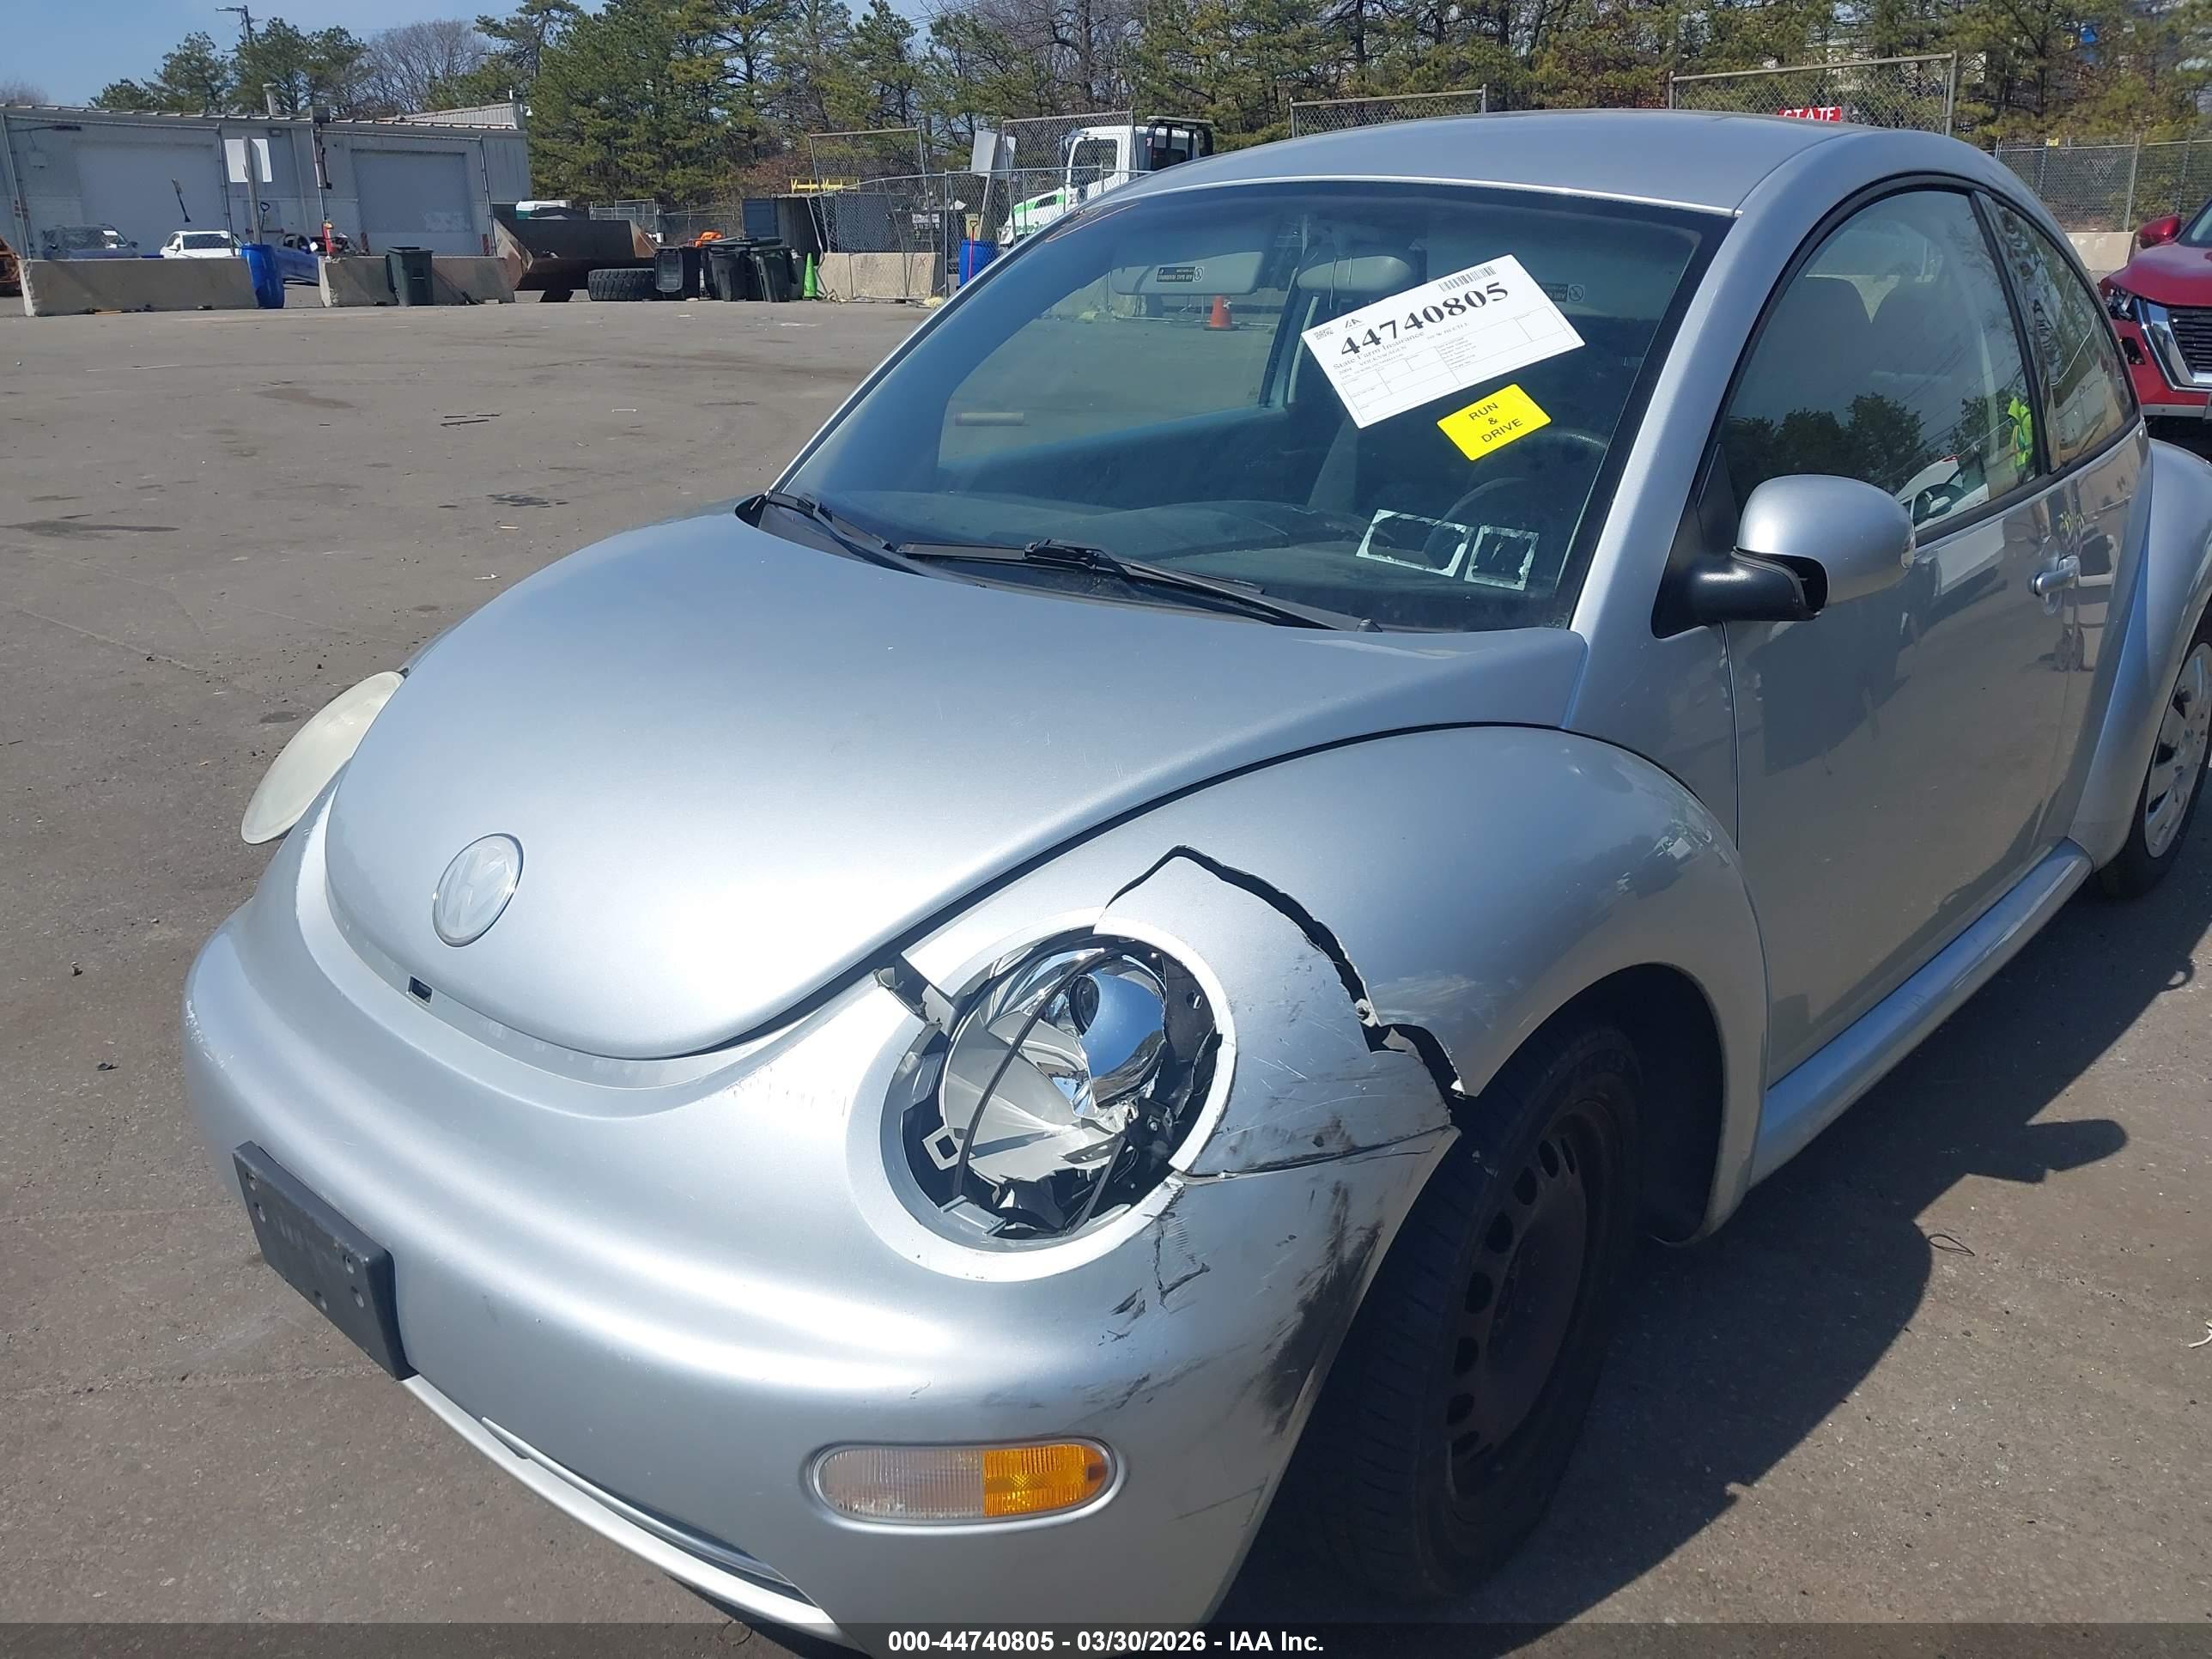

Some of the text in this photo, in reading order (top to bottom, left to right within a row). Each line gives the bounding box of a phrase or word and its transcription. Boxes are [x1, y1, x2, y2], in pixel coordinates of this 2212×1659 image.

[1341, 282, 1509, 355] 44740805
[1333, 357, 1356, 370] State
[1357, 348, 1381, 361] Farm
[1382, 331, 1425, 351] Insurance
[1468, 402, 1498, 421] RUN
[1487, 416, 1498, 425] &
[1480, 418, 1523, 443] DRIVE
